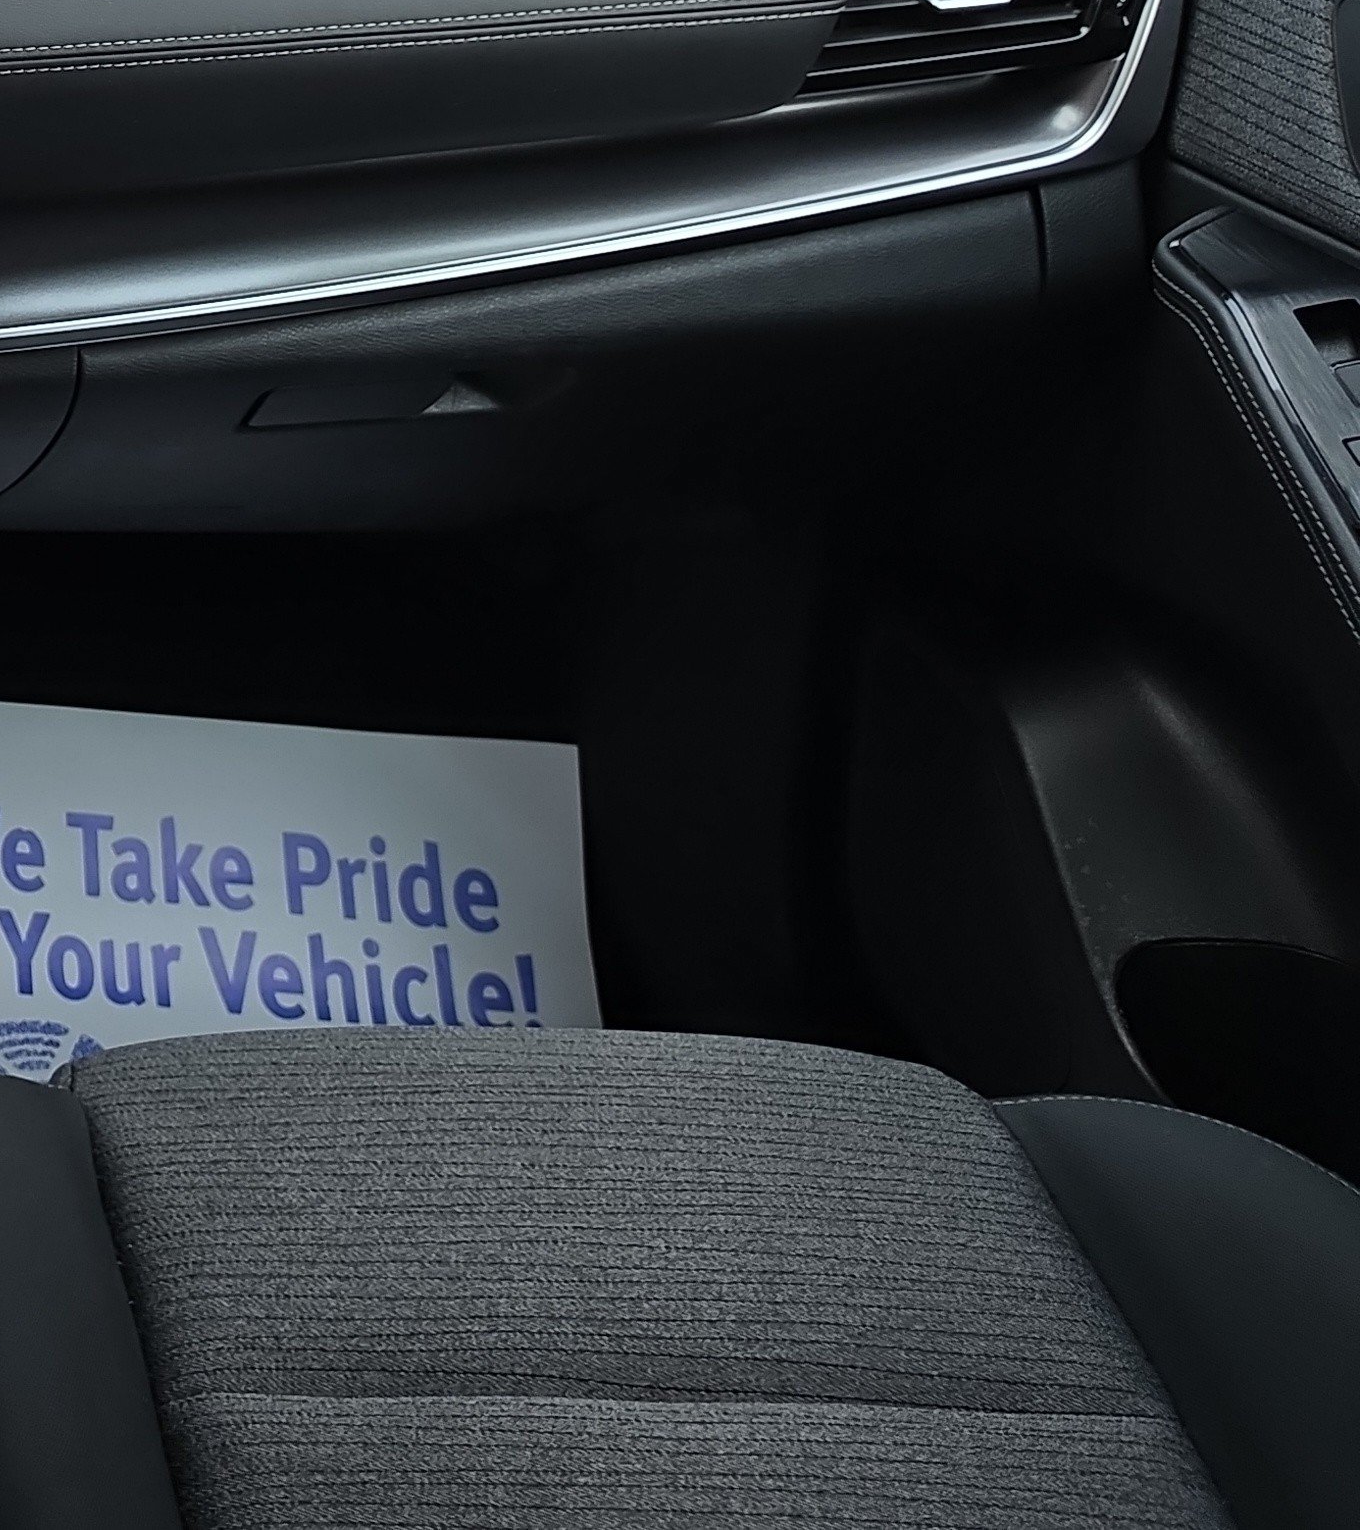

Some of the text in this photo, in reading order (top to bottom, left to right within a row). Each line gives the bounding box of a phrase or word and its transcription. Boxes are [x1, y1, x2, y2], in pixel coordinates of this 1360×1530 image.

[65, 810, 255, 912] Take
[281, 830, 501, 934] Pride
[196, 925, 544, 1029] Vehicle!
